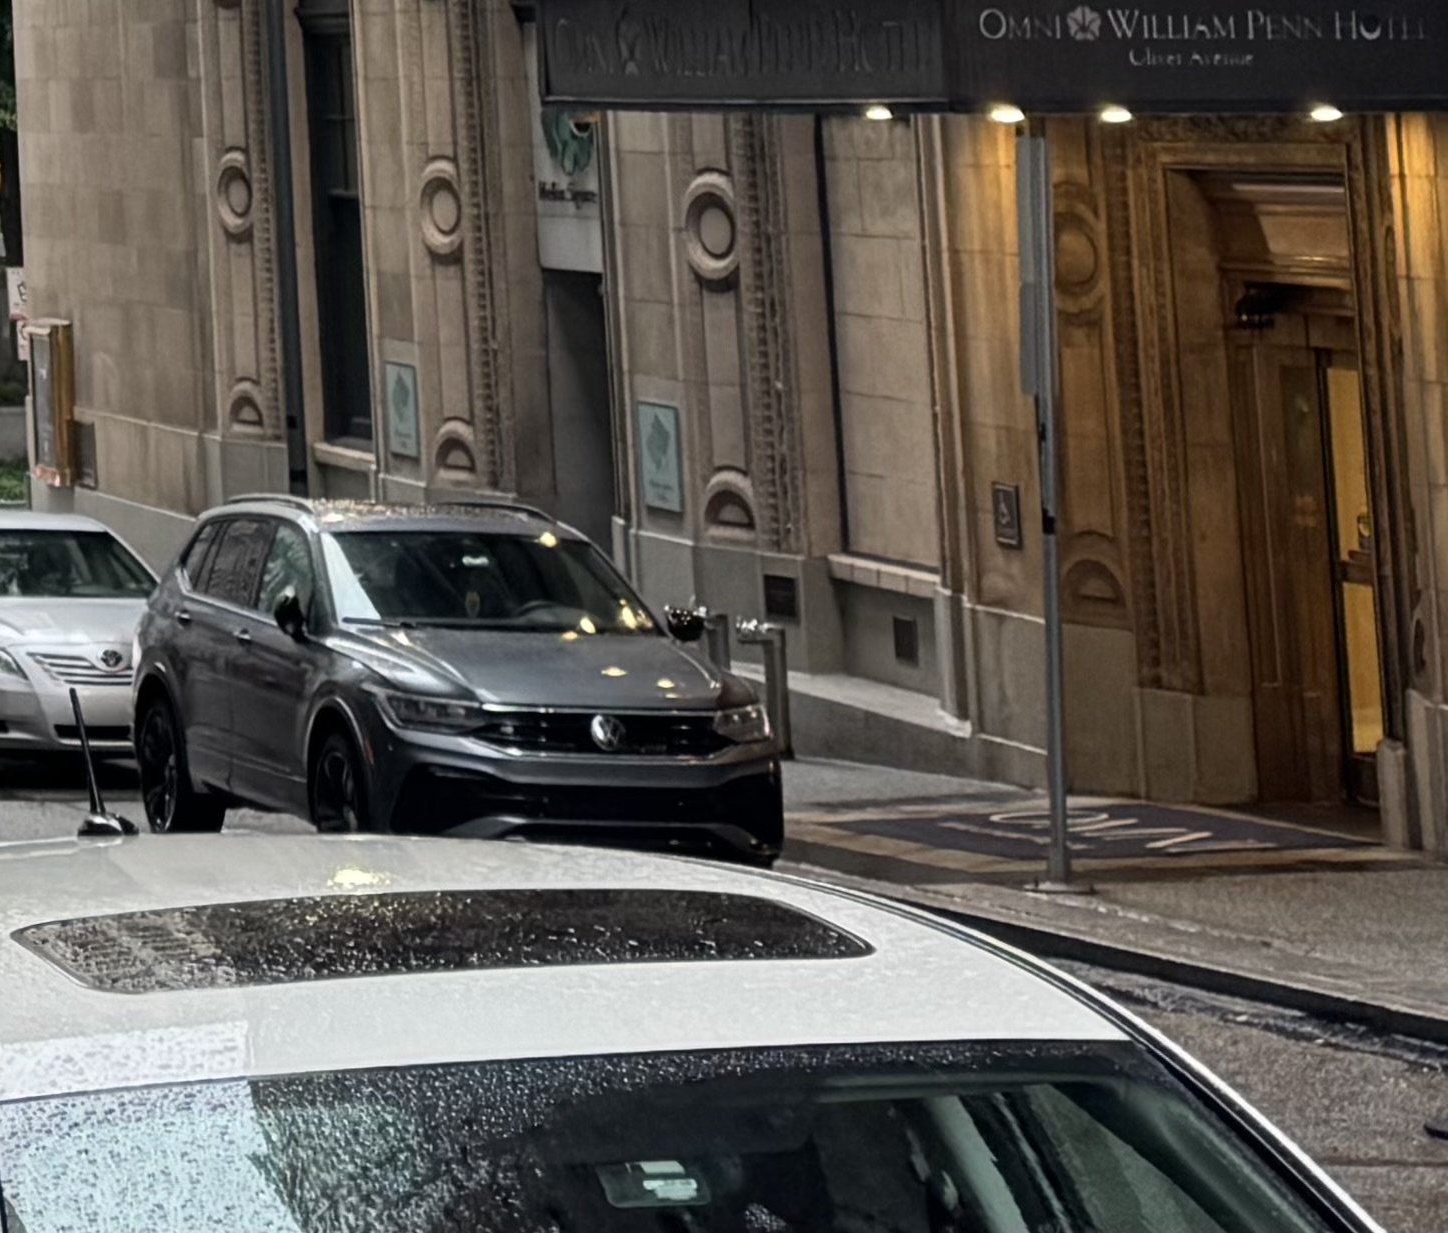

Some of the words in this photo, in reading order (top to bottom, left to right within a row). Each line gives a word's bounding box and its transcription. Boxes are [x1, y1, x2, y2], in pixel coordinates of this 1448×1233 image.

[979, 8, 1061, 40] OMNI
[1107, 8, 1236, 40] WILLIAM
[1246, 8, 1323, 40] PENN
